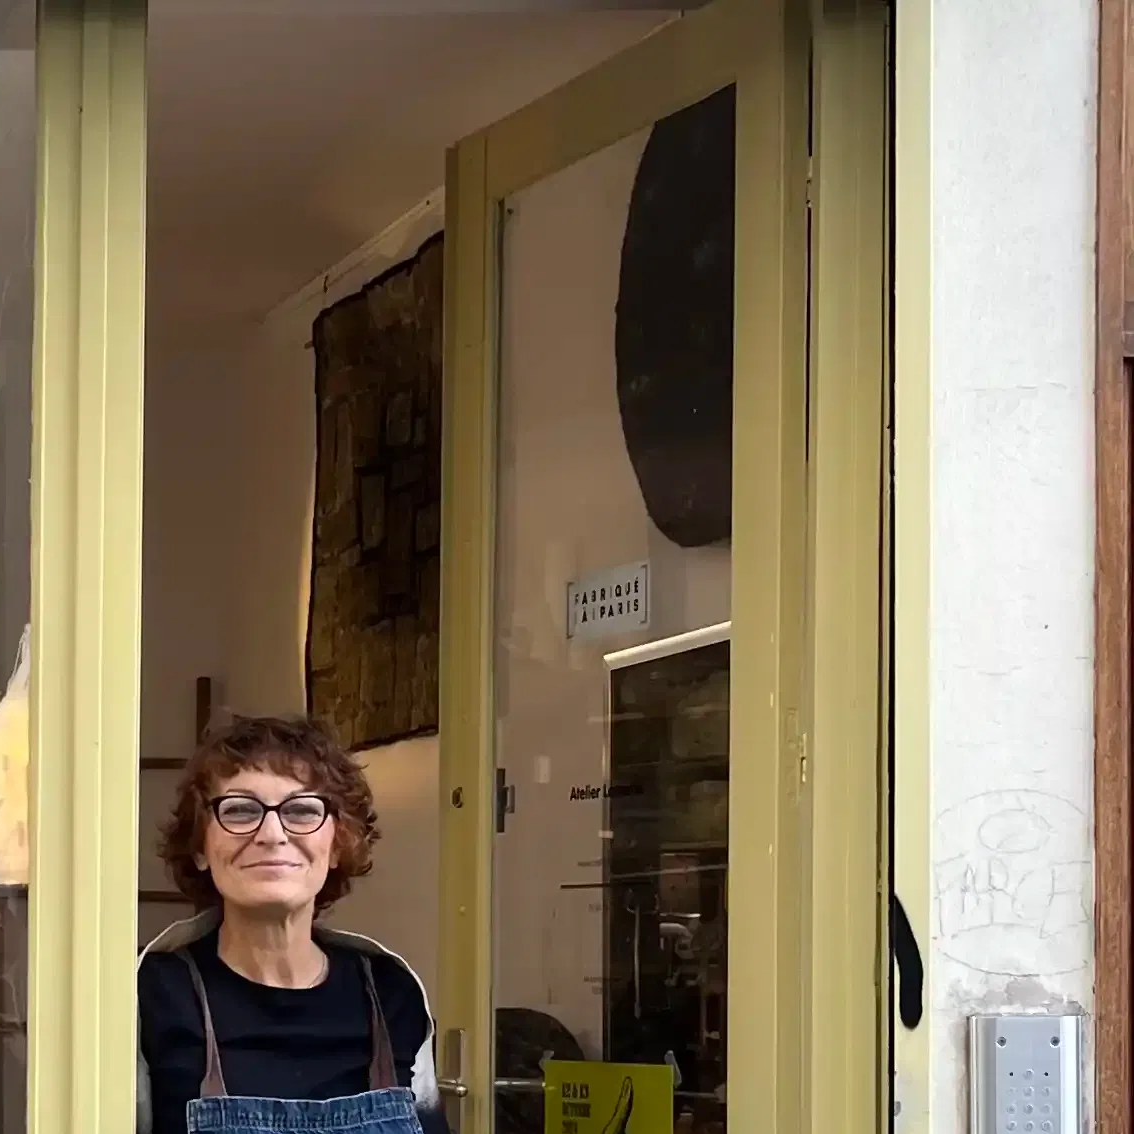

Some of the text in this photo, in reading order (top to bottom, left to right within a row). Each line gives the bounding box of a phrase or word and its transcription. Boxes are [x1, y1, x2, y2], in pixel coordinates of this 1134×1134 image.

[573, 576, 640, 606] FABRIQUÉ
[599, 598, 640, 620] PARIS
[569, 784, 601, 801] Atelier
